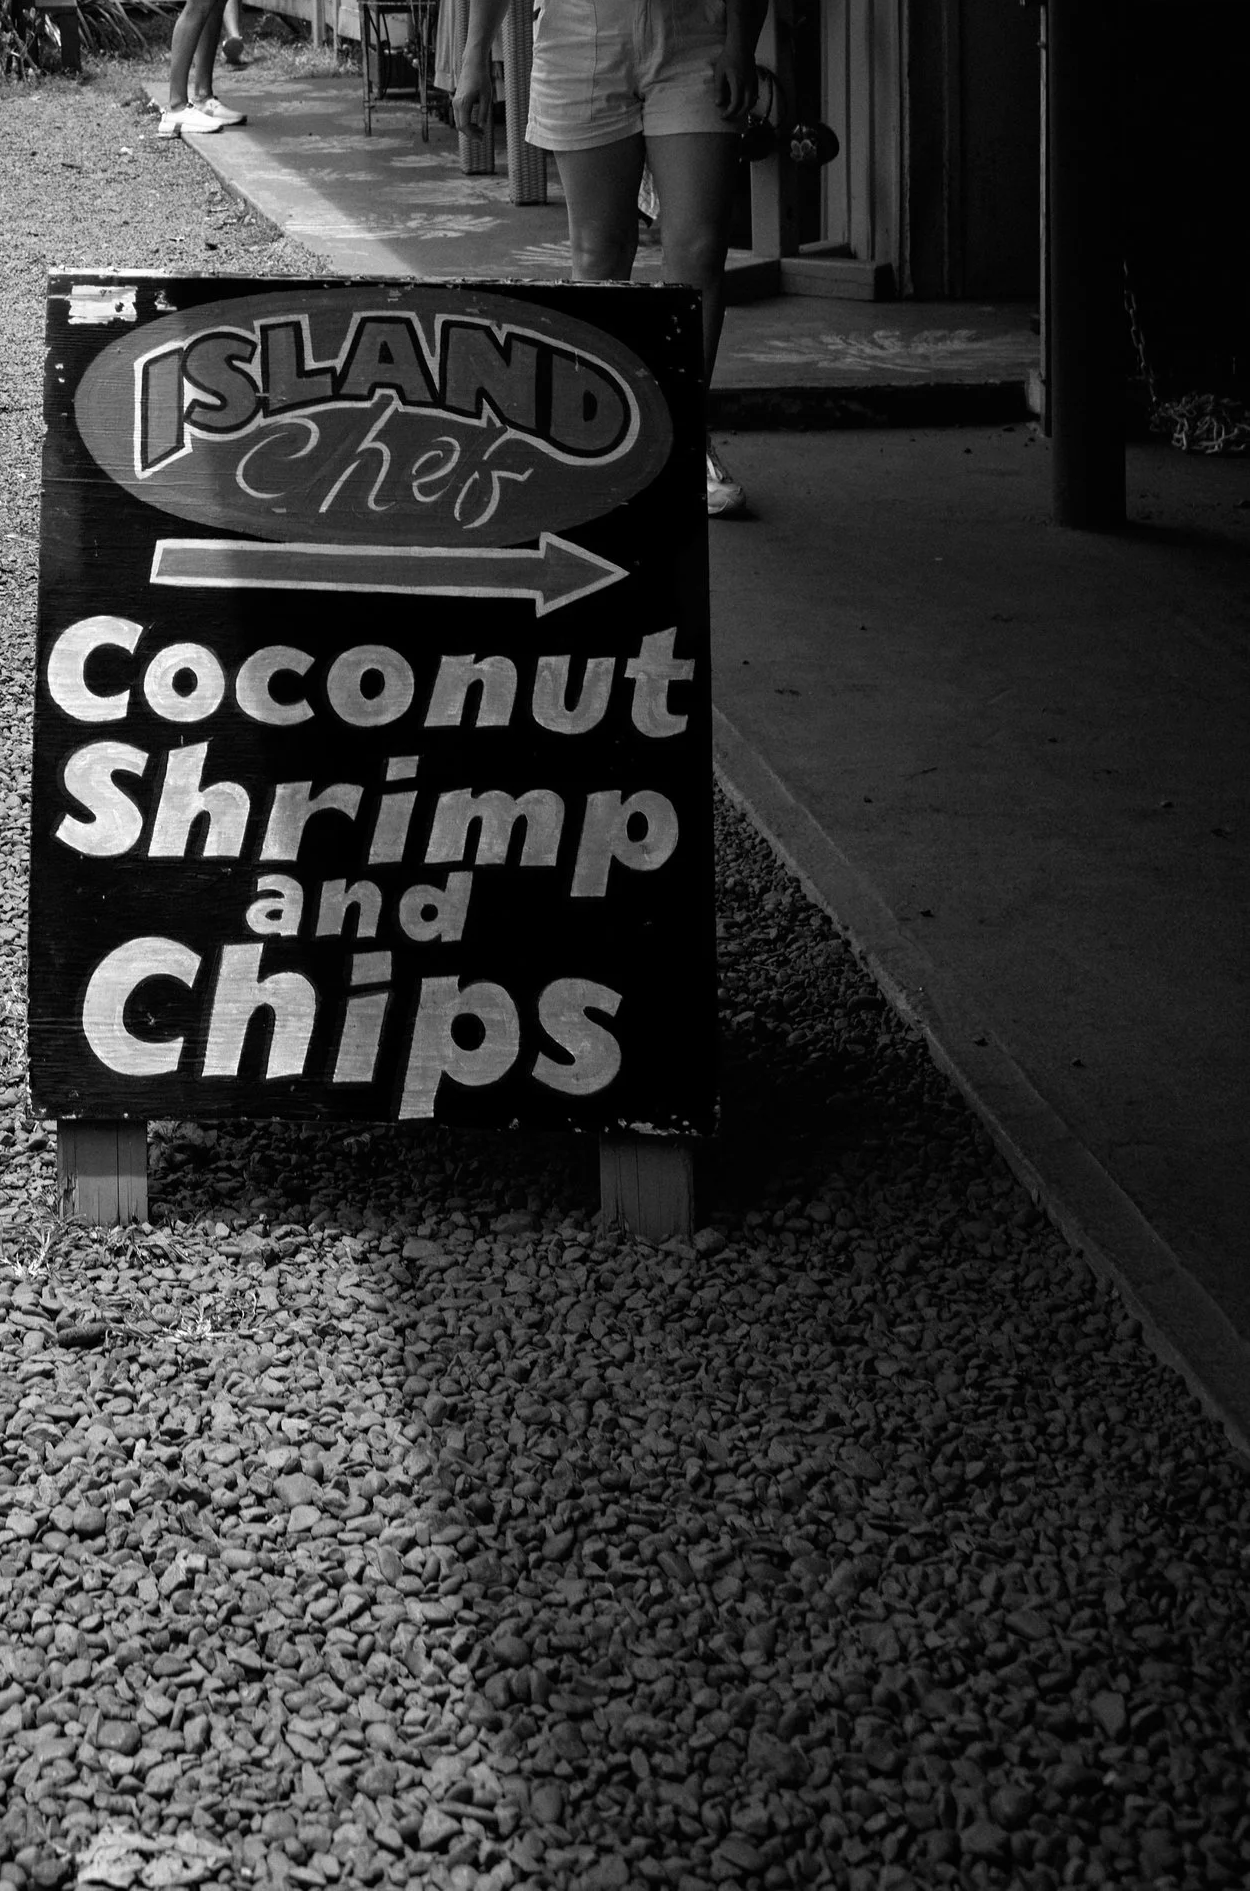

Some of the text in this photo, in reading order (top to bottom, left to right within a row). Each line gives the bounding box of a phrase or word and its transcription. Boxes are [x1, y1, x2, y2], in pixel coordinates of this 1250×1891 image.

[133, 311, 641, 480] ISLAND
[47, 614, 696, 739] Coconut
[55, 740, 679, 899] Shrimp
[244, 870, 474, 944] and
[82, 936, 623, 1120] Chips
